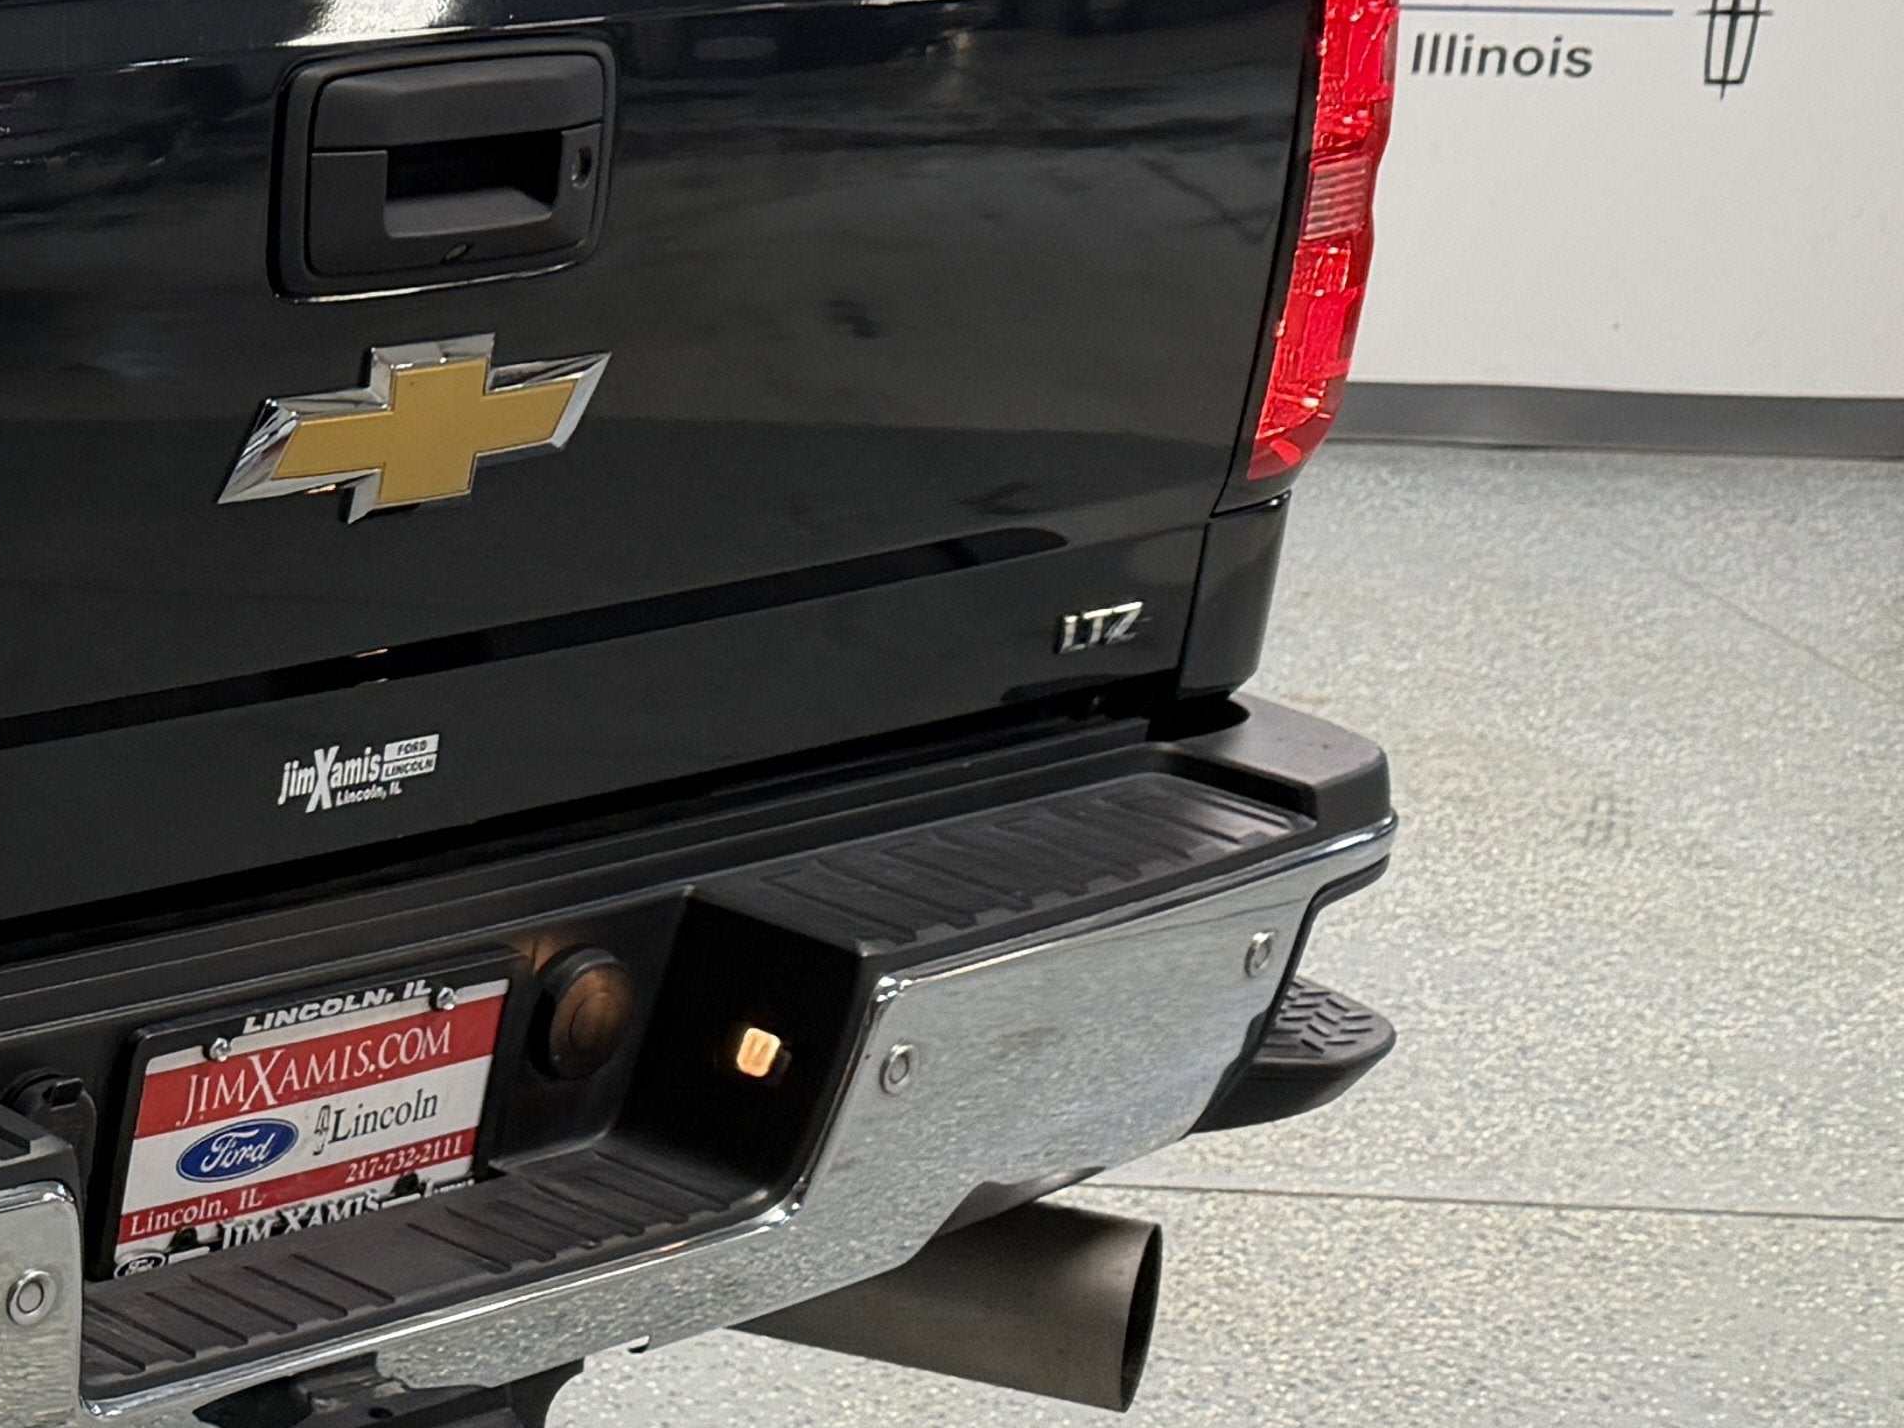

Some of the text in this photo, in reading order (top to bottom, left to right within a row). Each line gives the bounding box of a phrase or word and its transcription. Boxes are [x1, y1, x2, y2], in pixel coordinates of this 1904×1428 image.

[1410, 33, 1594, 78] Illinois
[1059, 601, 1144, 654] LTZ
[384, 758, 435, 778] LINCOLN
[396, 739, 428, 756] FORD
[403, 979, 432, 1004] IL
[332, 1088, 438, 1142] Lincoln
[199, 1129, 274, 1173] Ford
[129, 1135, 464, 1237] Lincoln, IL 217-732-2111
